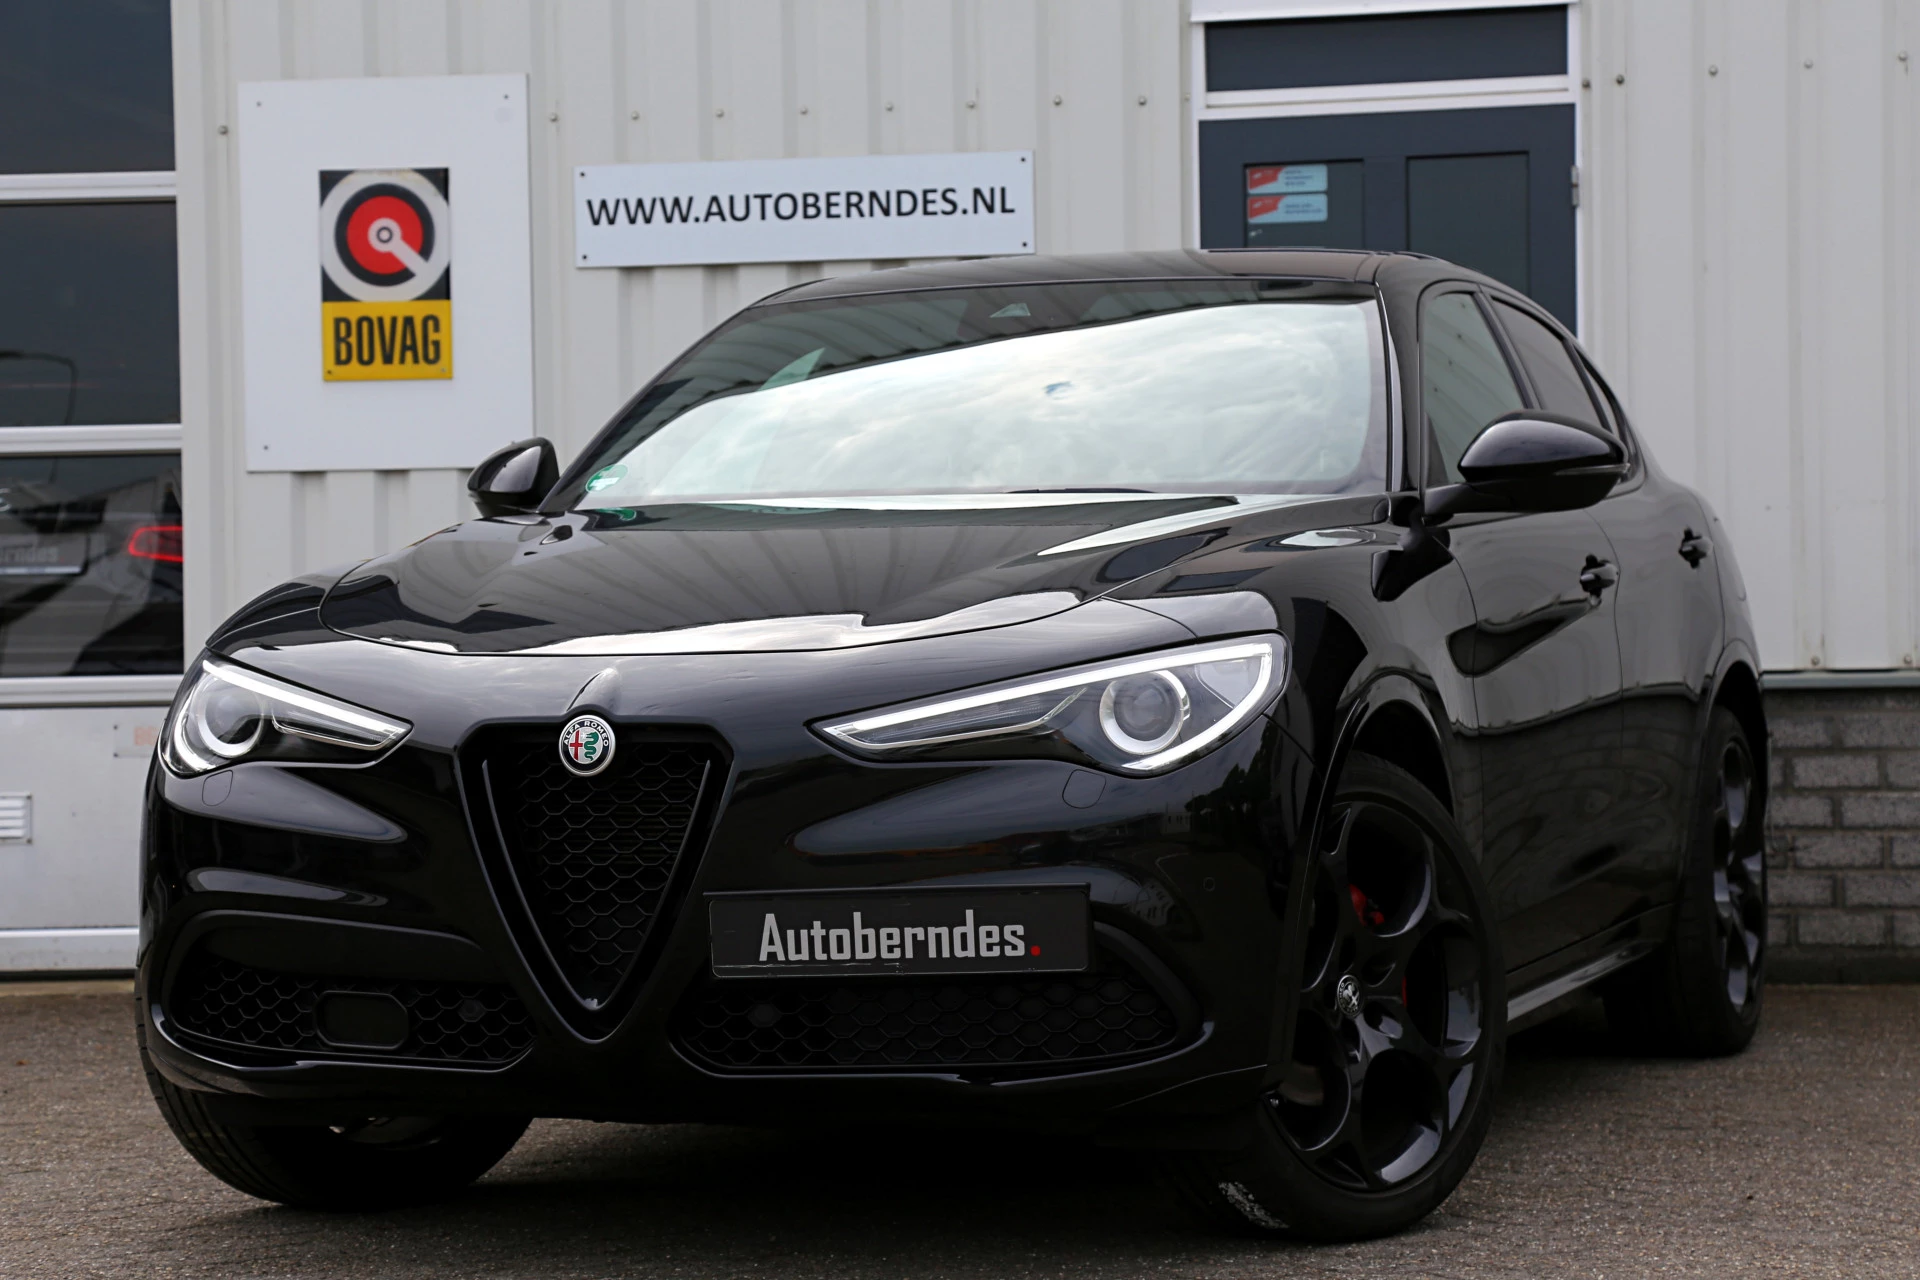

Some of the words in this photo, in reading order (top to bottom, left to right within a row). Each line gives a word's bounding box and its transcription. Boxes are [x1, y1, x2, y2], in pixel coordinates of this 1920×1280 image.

[586, 186, 1016, 226] WWW.AUTOBERNDES.NL
[332, 314, 442, 367] BOVAG
[563, 723, 581, 746] ALFA
[583, 720, 609, 747] ROMEO
[758, 909, 1041, 962] Autoberndes.
